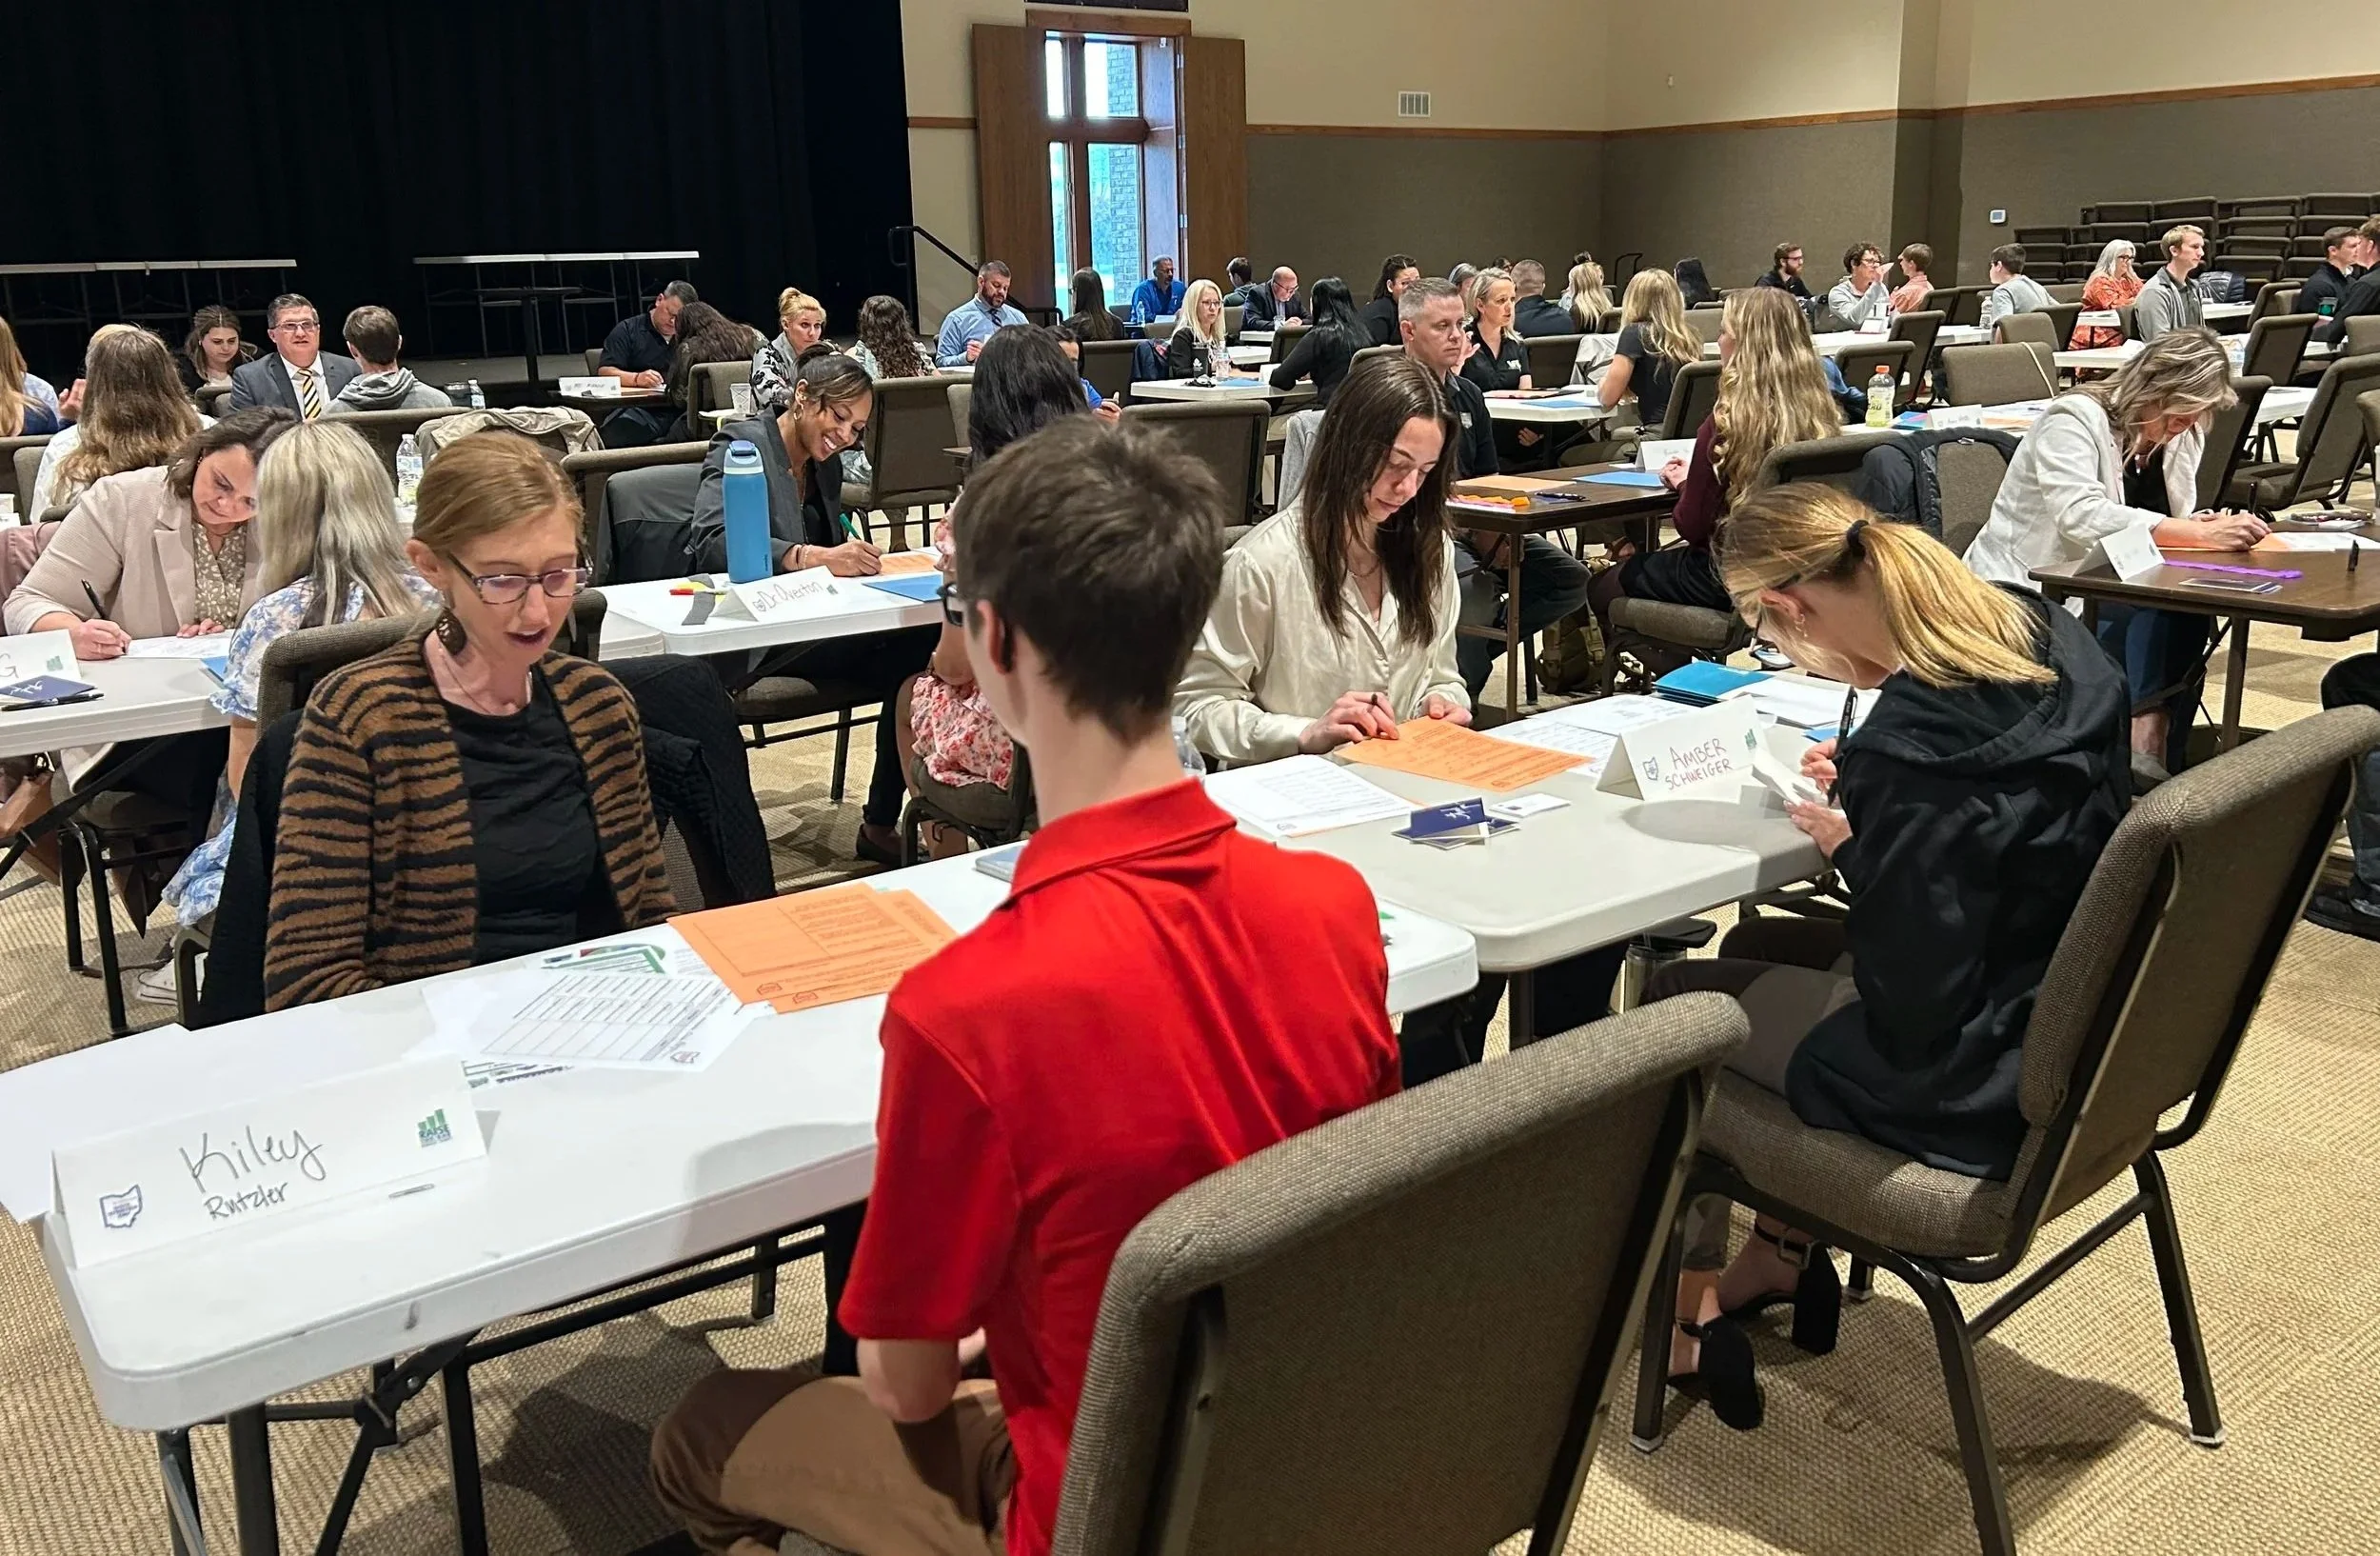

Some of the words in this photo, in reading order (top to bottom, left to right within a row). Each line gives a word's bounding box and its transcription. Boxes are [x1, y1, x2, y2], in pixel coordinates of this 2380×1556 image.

[1669, 738, 1728, 770] AMBER
[1664, 758, 1734, 790] SCHWEIGER
[178, 1125, 327, 1194] Kiley
[203, 1182, 289, 1221] Rutzler
